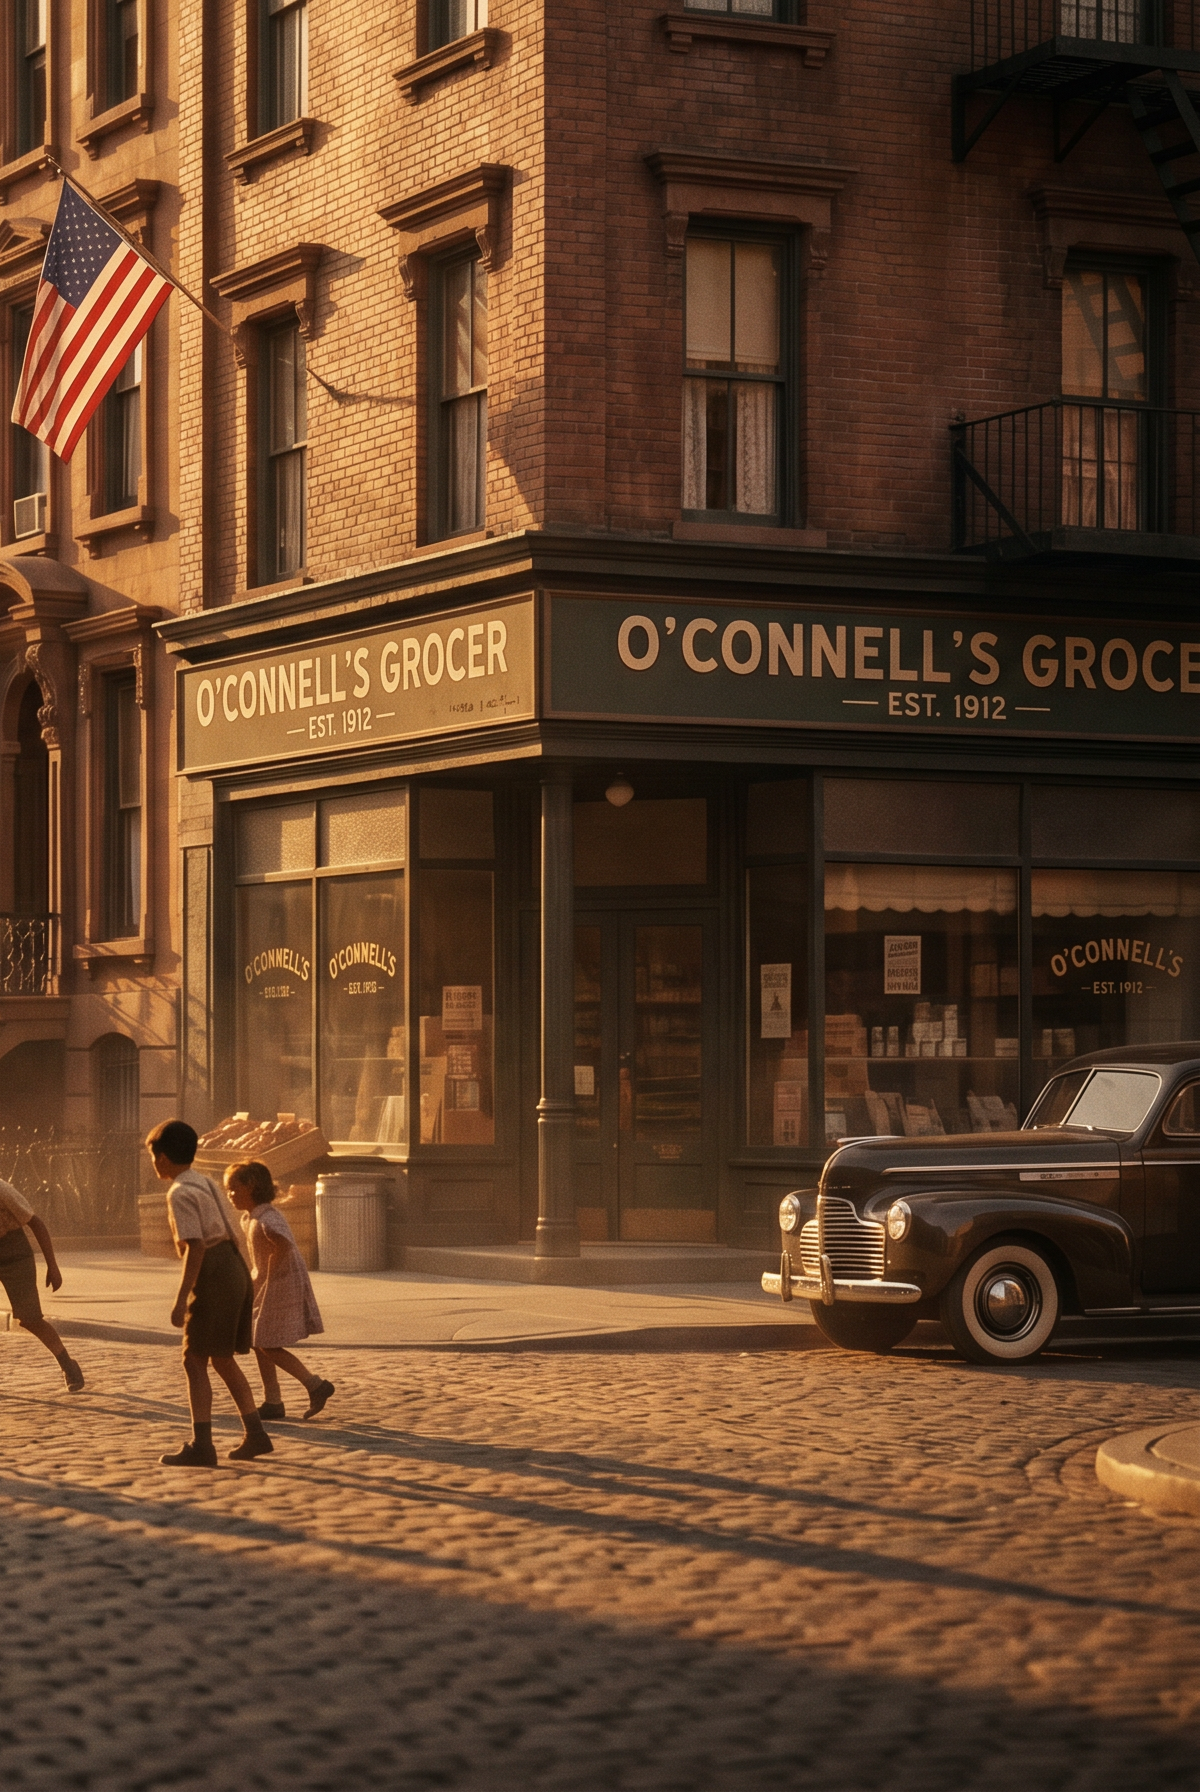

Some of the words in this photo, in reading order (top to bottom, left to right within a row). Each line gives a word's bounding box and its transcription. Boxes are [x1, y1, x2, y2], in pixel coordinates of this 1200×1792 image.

[618, 614, 1001, 686] O'CONNELL'S
[196, 647, 370, 727] O'CONNELL'S
[380, 620, 508, 694] GROCER
[308, 714, 337, 740] EST.
[342, 706, 372, 734] 1912
[888, 692, 941, 718] EST.
[953, 694, 1007, 720] 1912
[244, 948, 310, 985] O'CONNELL'S
[329, 941, 397, 980] O'CONNELL'S
[1051, 938, 1184, 978] O'CONNELL'S
[1093, 981, 1117, 995] EST.
[1119, 981, 1143, 994] 1912
